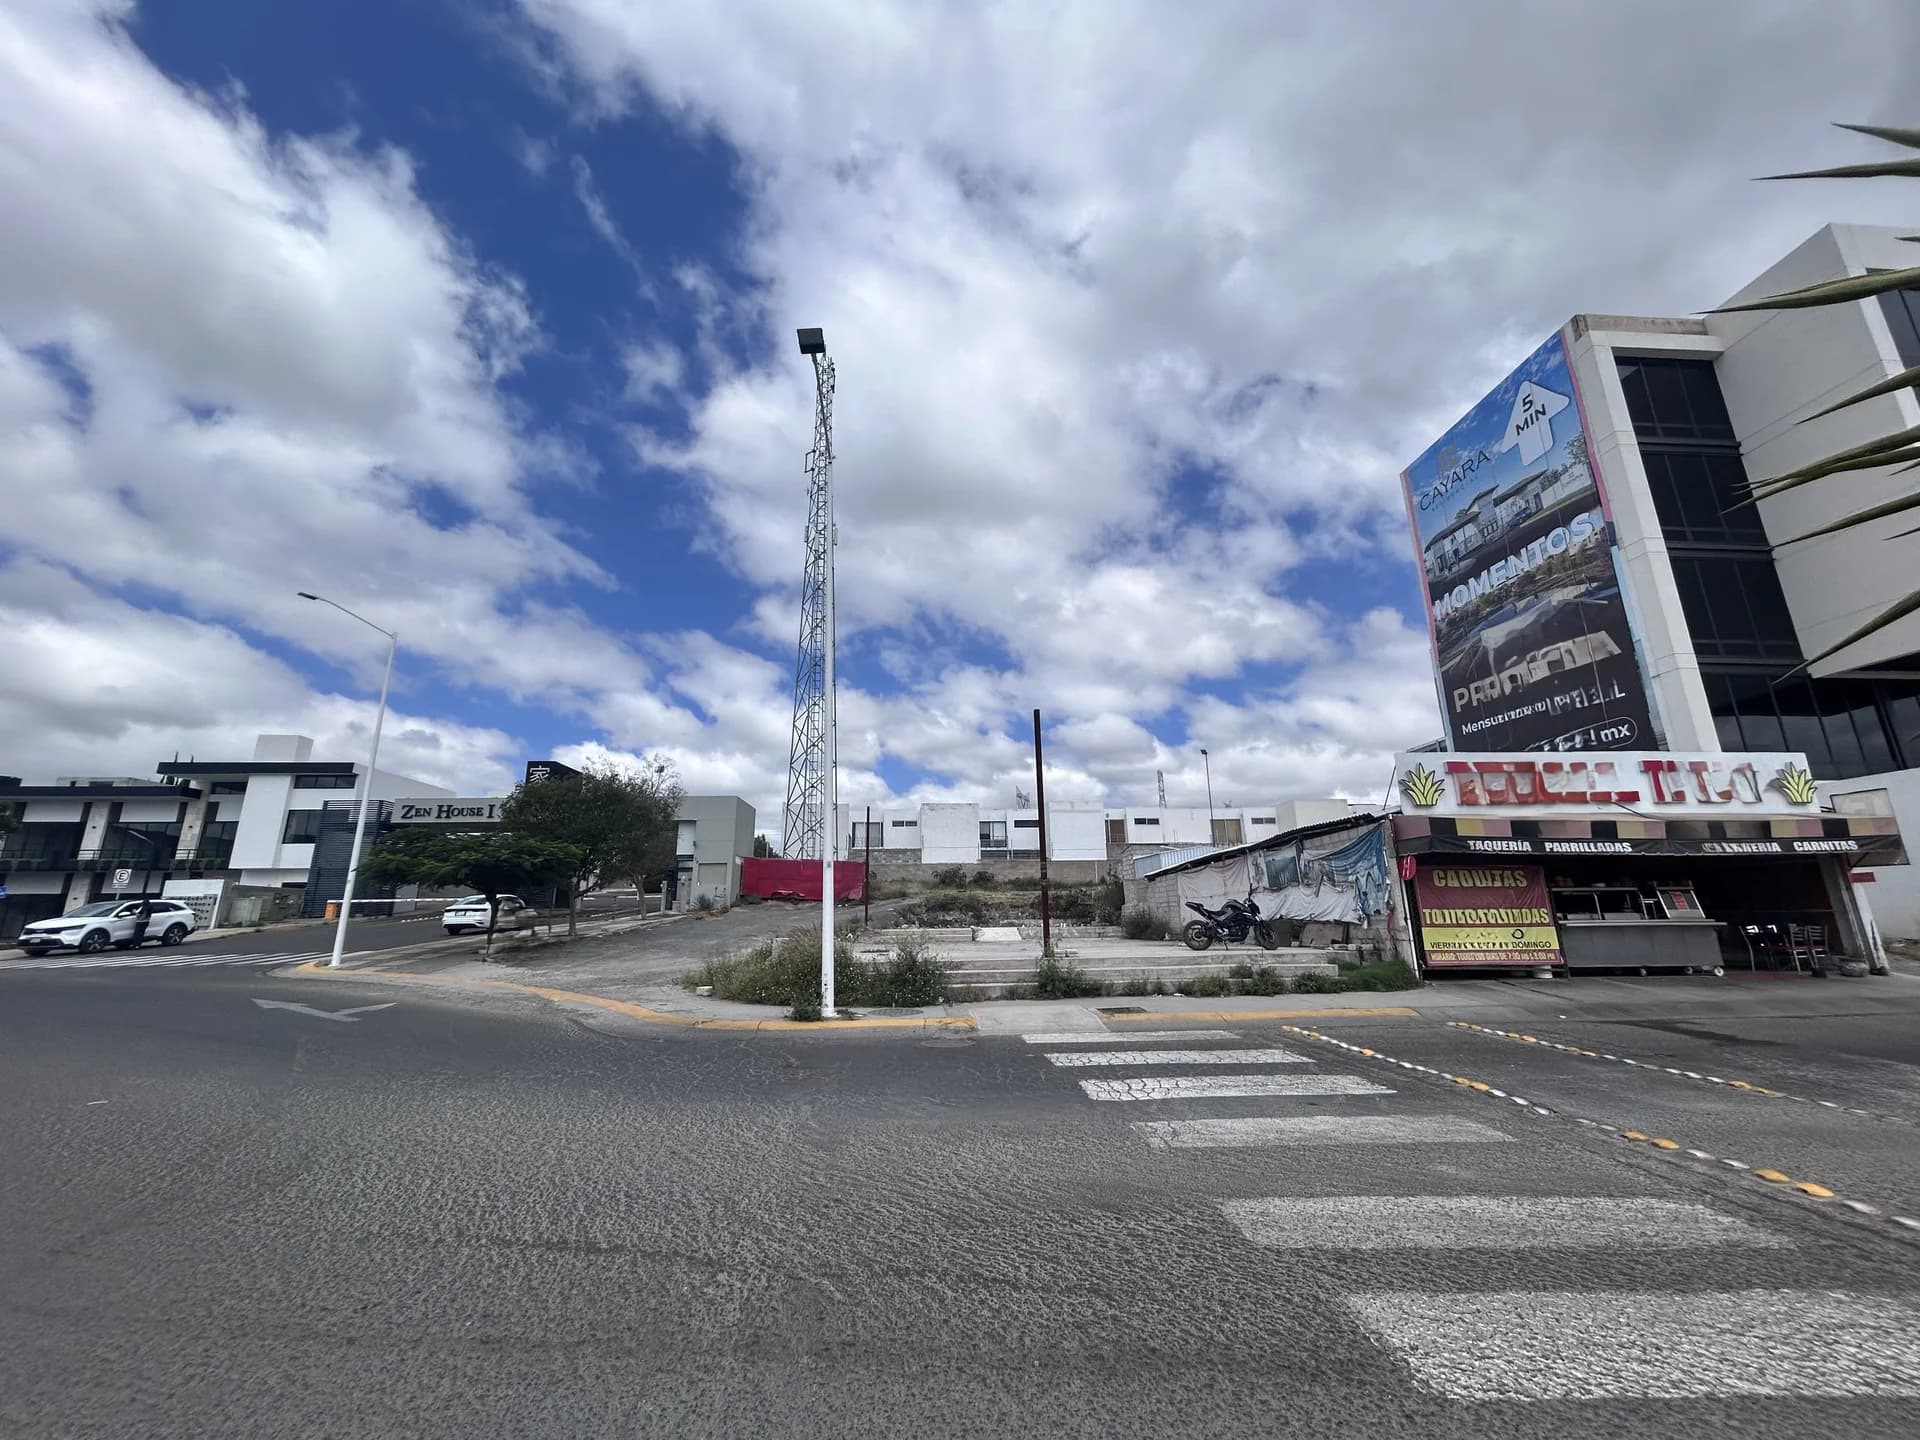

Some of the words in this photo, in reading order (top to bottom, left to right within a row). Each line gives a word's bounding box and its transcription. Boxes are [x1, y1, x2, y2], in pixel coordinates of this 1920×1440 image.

[1522, 393, 1533, 413] 5
[1515, 403, 1547, 436] MIN
[1419, 450, 1490, 511] CAYARA
[1433, 512, 1595, 620] MOMENTOS
[401, 805, 432, 819] ZEN
[435, 805, 484, 819] HOUSE
[1467, 840, 1532, 852] TAQUERÍA
[1544, 842, 1633, 853] PARRILLADAS
[1793, 840, 1858, 851] CARNITAS
[1512, 941, 1552, 949] DOMINGO
